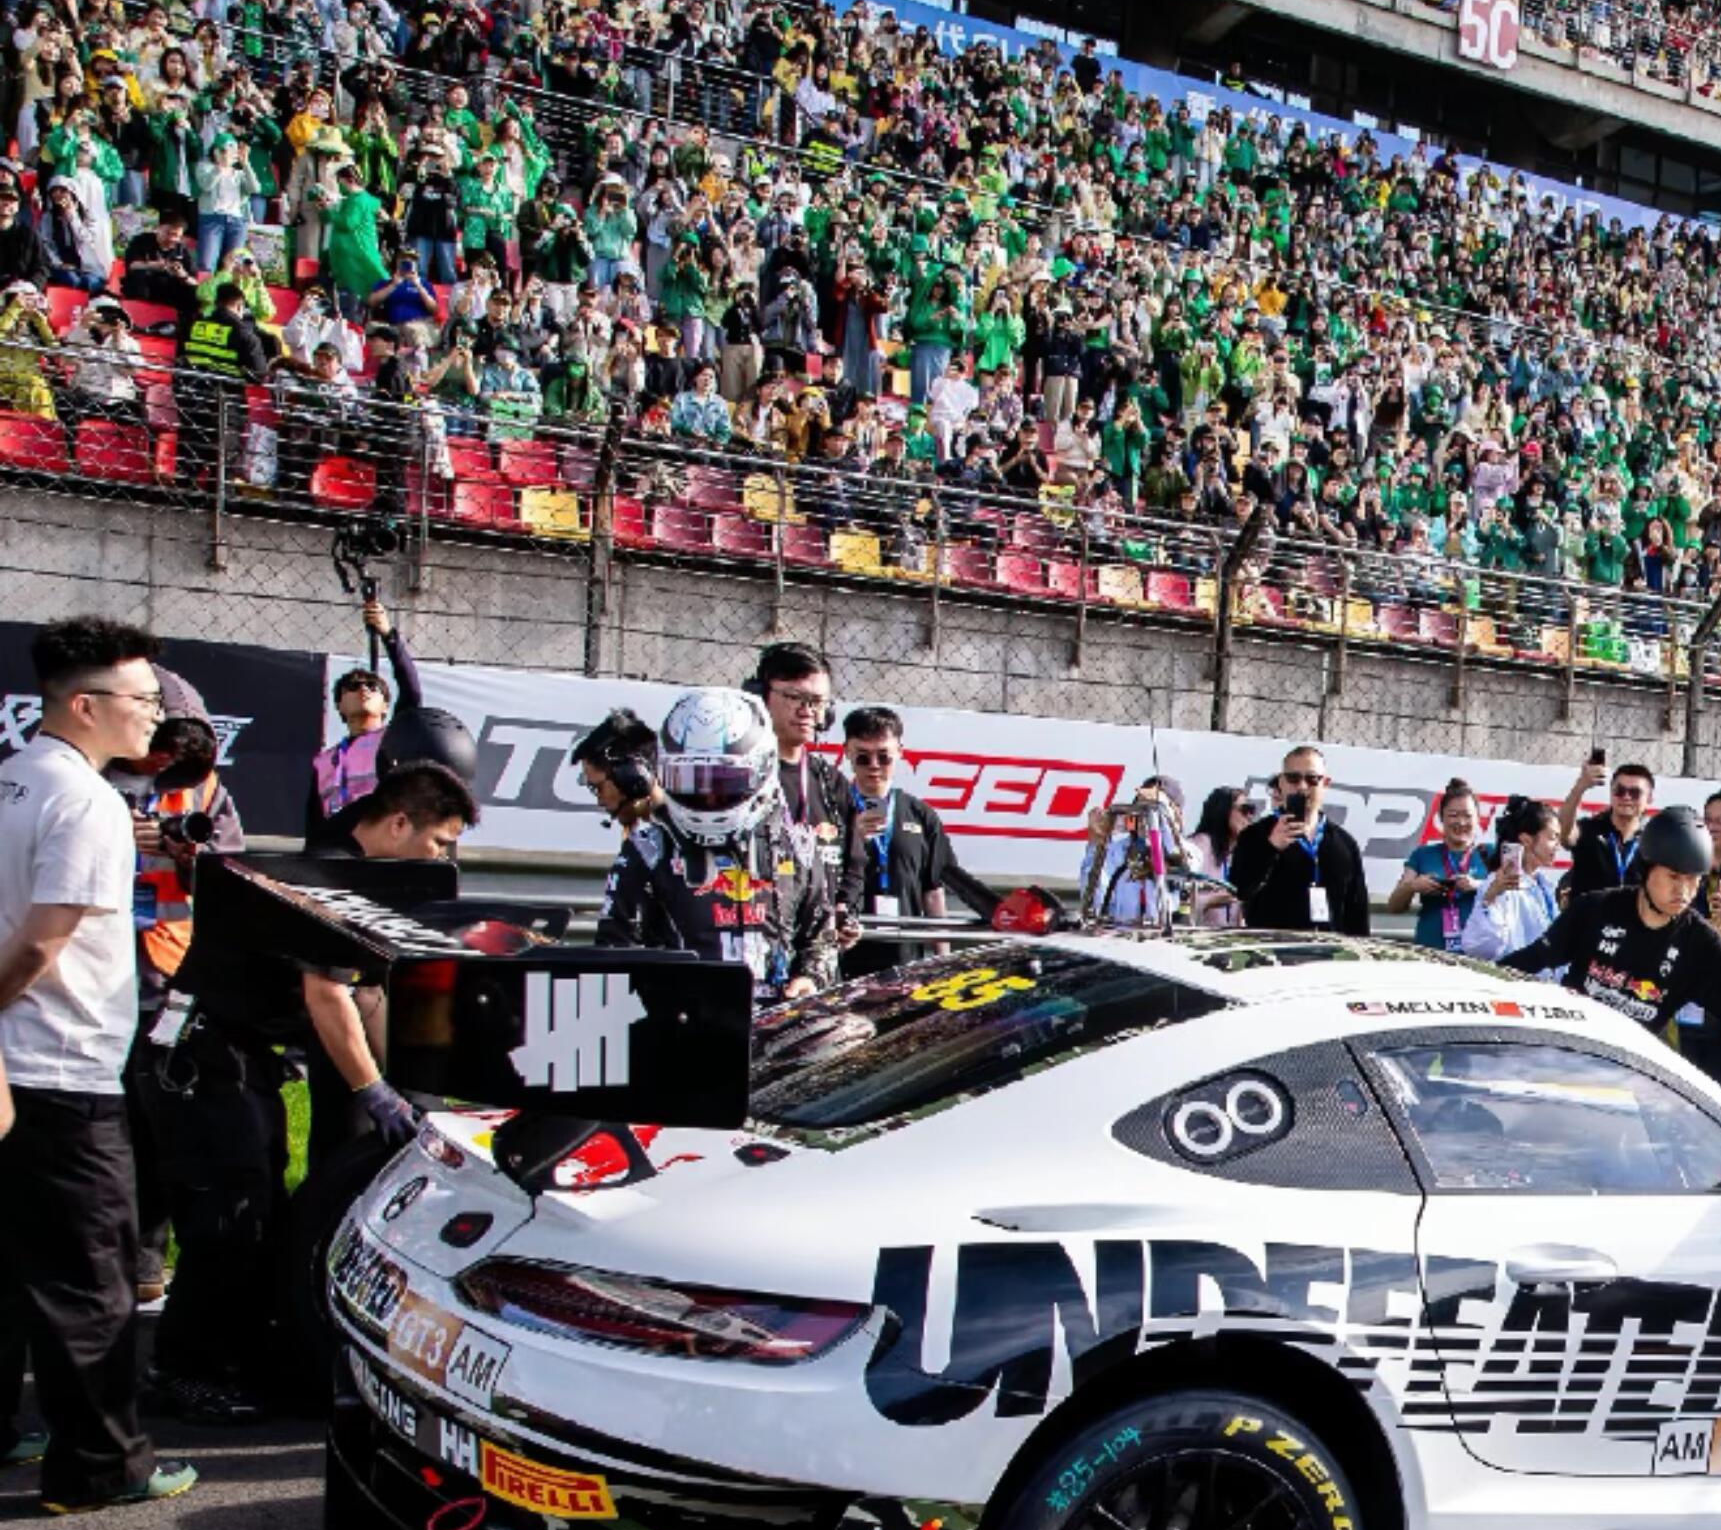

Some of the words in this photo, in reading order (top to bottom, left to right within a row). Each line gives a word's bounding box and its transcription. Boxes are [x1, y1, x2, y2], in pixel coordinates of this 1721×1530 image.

[910, 968, 1038, 1011] 85
[395, 1312, 448, 1368] GT3
[448, 1343, 498, 1393] AM
[1223, 1415, 1264, 1438] P
[1659, 1431, 1707, 1461] AM
[484, 1446, 606, 1513] PIRELLI
